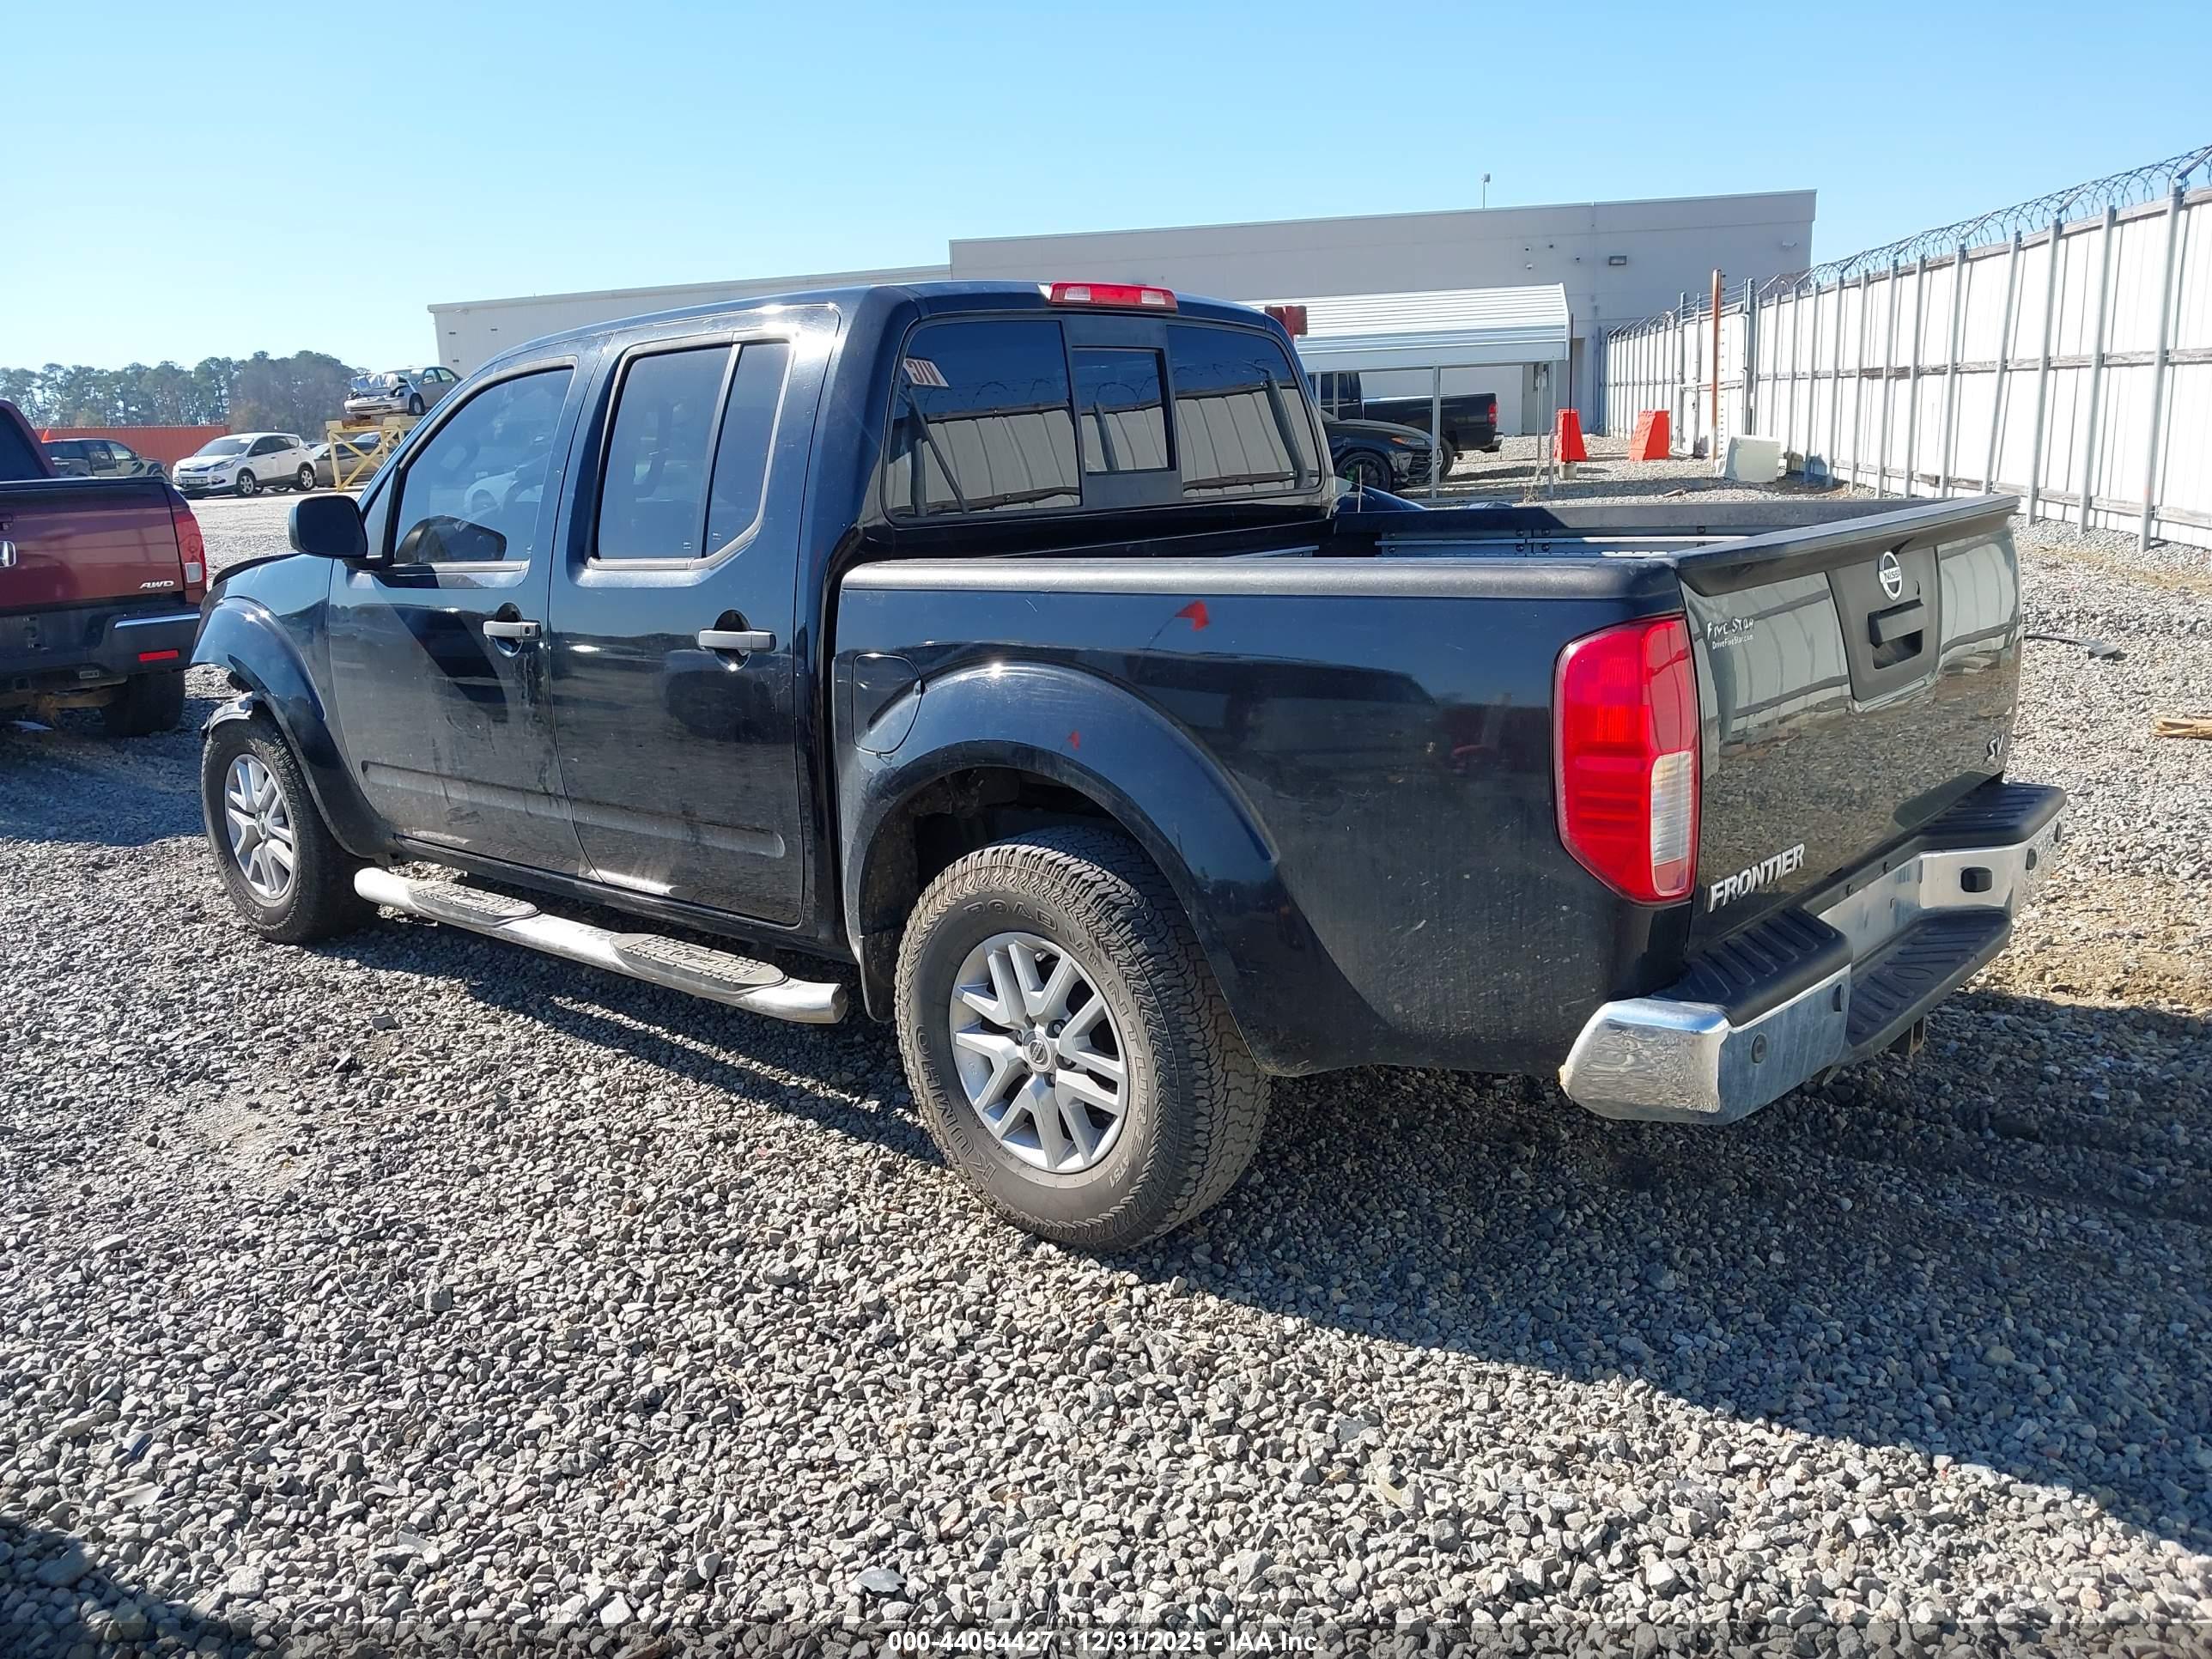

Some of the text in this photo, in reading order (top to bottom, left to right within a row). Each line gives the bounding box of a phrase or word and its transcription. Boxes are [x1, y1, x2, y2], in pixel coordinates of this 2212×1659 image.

[139, 580, 174, 589] AWD
[1984, 734, 2005, 763] SV
[1705, 843, 1805, 914] FRONTIER
[915, 1024, 997, 1183] KUMHO
